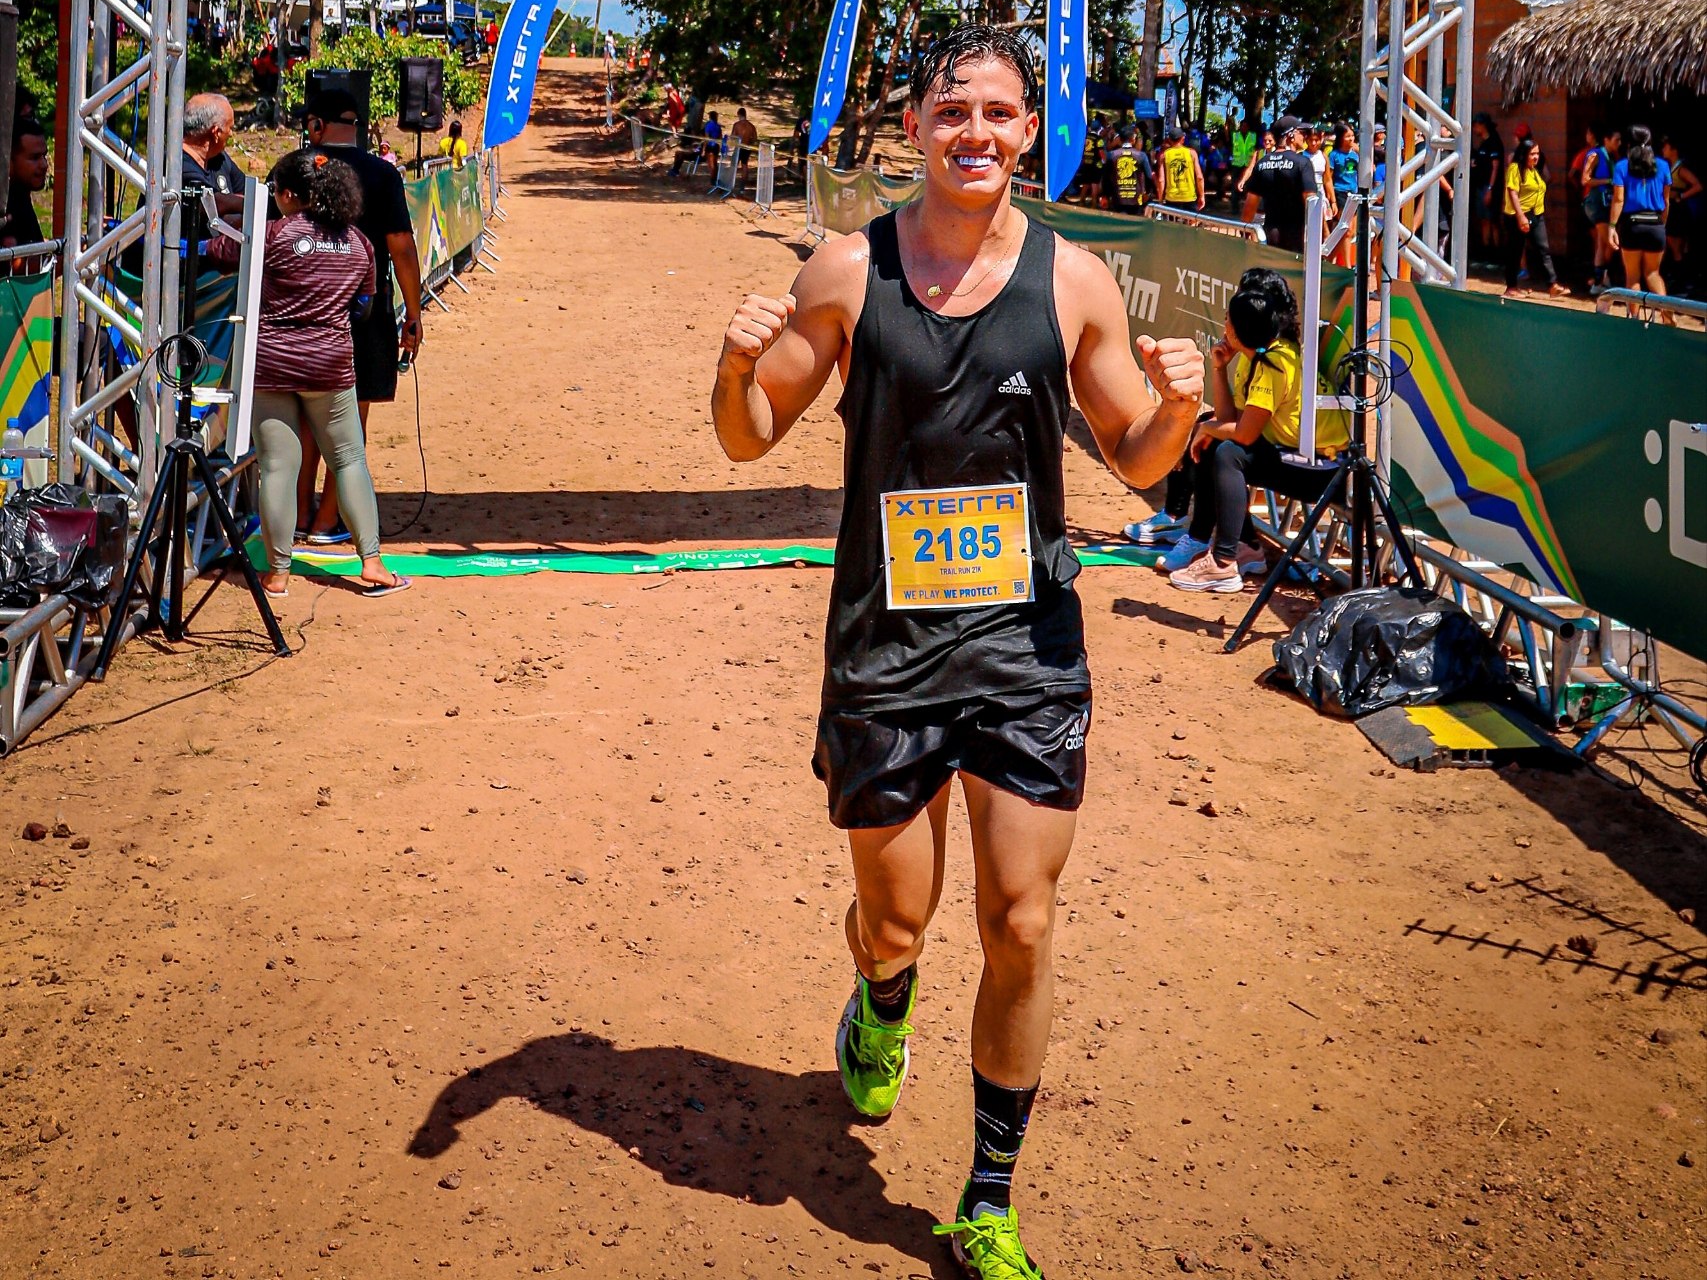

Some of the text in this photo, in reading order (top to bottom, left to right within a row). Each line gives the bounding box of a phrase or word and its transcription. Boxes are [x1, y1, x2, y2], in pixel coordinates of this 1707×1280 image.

[506, 3, 542, 104] XTERRA
[1175, 266, 1239, 310] XTERR
[998, 385, 1032, 395] adidas
[896, 494, 1015, 516] XTERRA
[913, 524, 1002, 563] 2185
[904, 590, 917, 600] WE
[944, 589, 957, 599] WE
[959, 585, 1000, 598] PROTECT.
